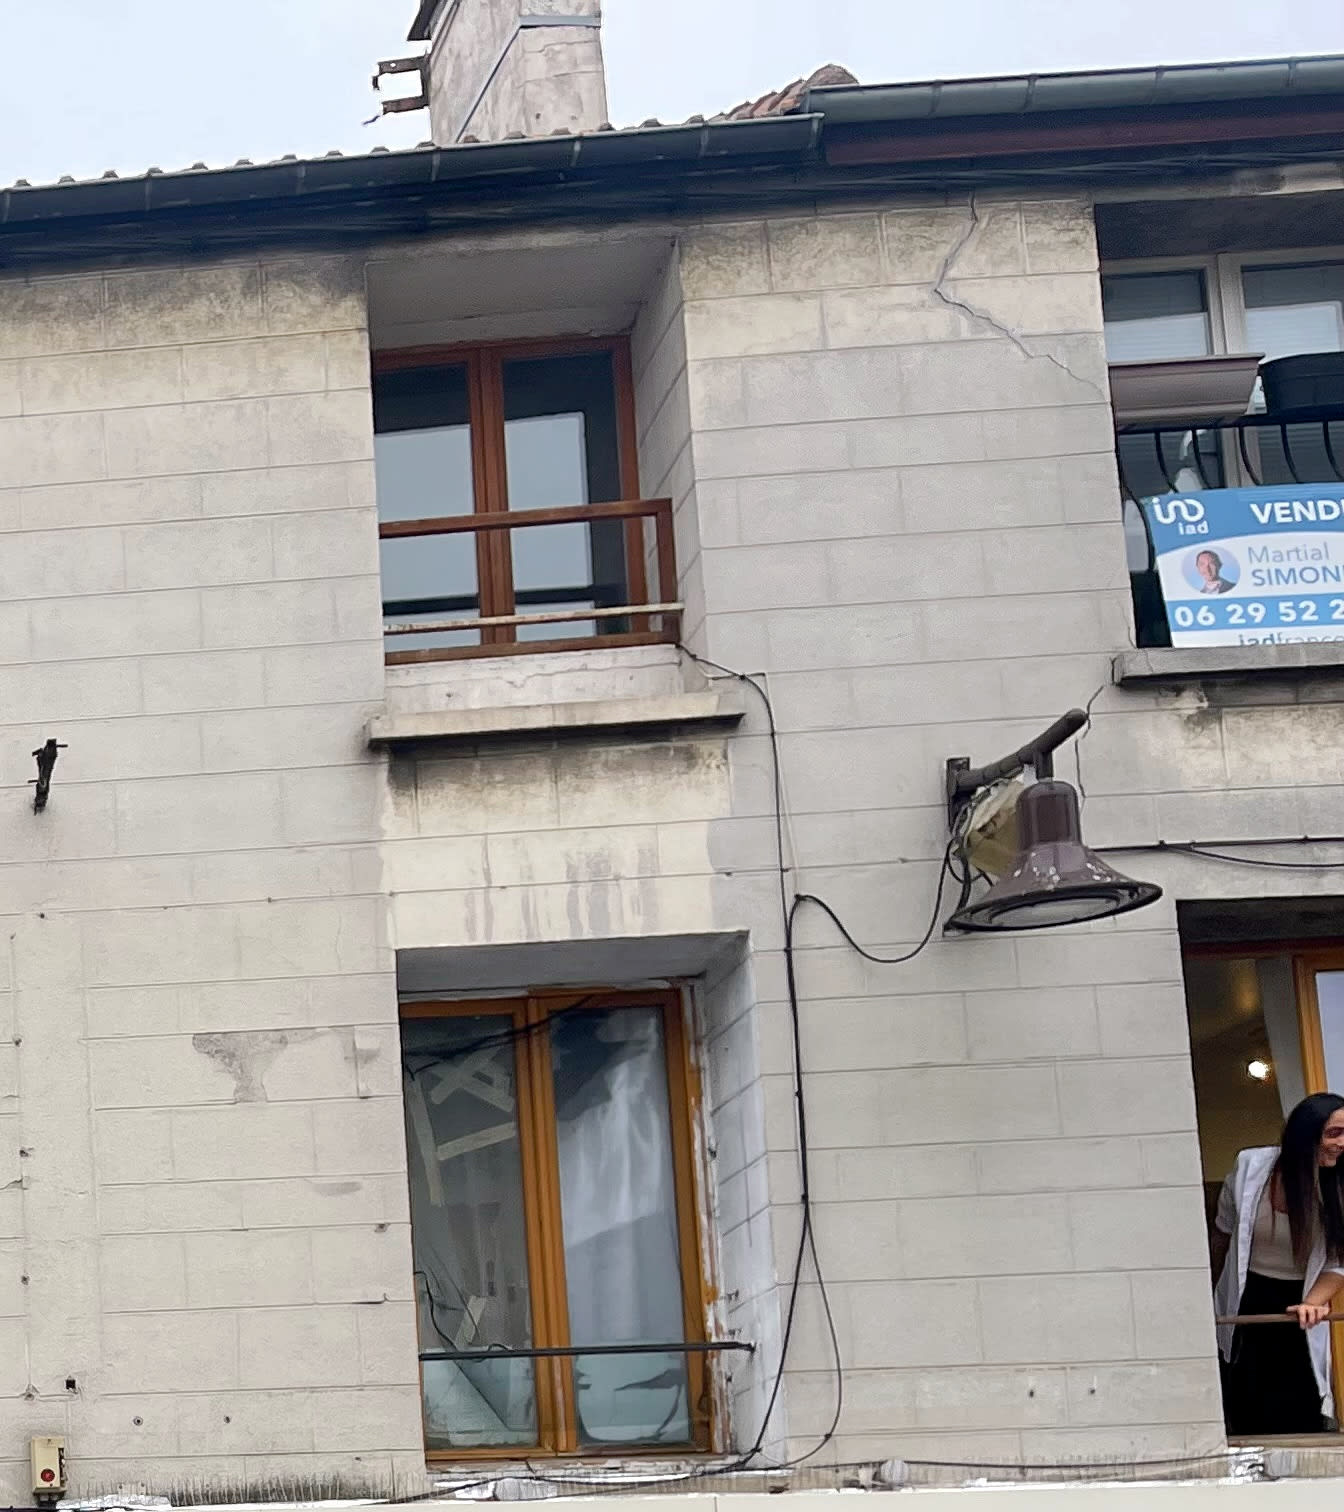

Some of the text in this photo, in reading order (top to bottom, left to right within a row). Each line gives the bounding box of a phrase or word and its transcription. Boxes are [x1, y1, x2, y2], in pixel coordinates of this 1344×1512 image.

[1250, 499, 1344, 524] VEND
[1248, 542, 1330, 565] Martial
[1251, 566, 1344, 587] SIMON
[1175, 606, 1216, 627] 06
[1226, 602, 1267, 625] 29
[1278, 600, 1319, 622] 52
